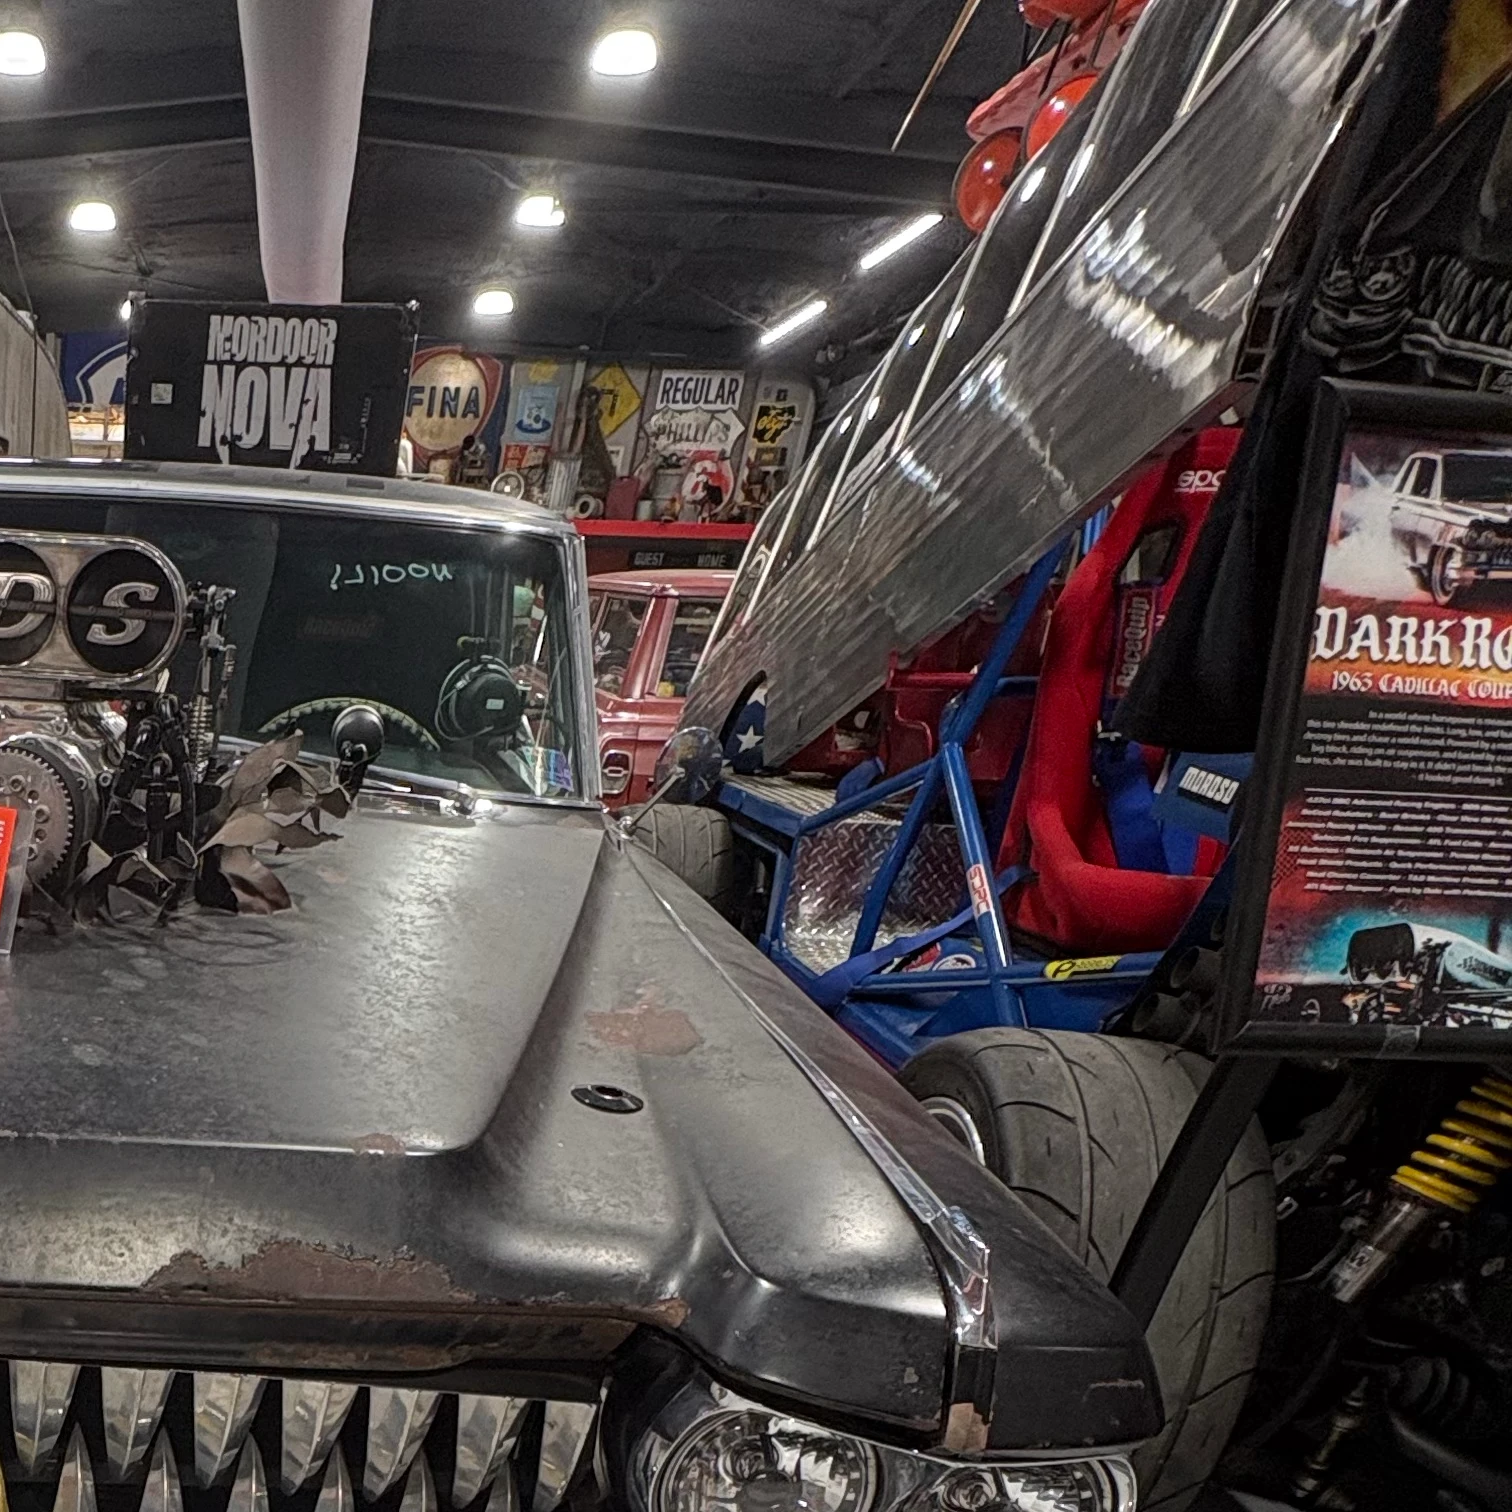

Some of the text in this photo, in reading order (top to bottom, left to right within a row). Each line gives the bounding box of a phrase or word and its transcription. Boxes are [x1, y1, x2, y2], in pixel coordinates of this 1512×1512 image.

[406, 385, 481, 420] FINA
[659, 376, 740, 406] REGULAR
[198, 365, 331, 469] NOVA
[633, 551, 665, 567] GUEST
[1311, 605, 1458, 666] DARK
[1332, 670, 1374, 693] 1963
[1378, 673, 1460, 698] CADILLAC
[1178, 765, 1240, 806] MOROSO
